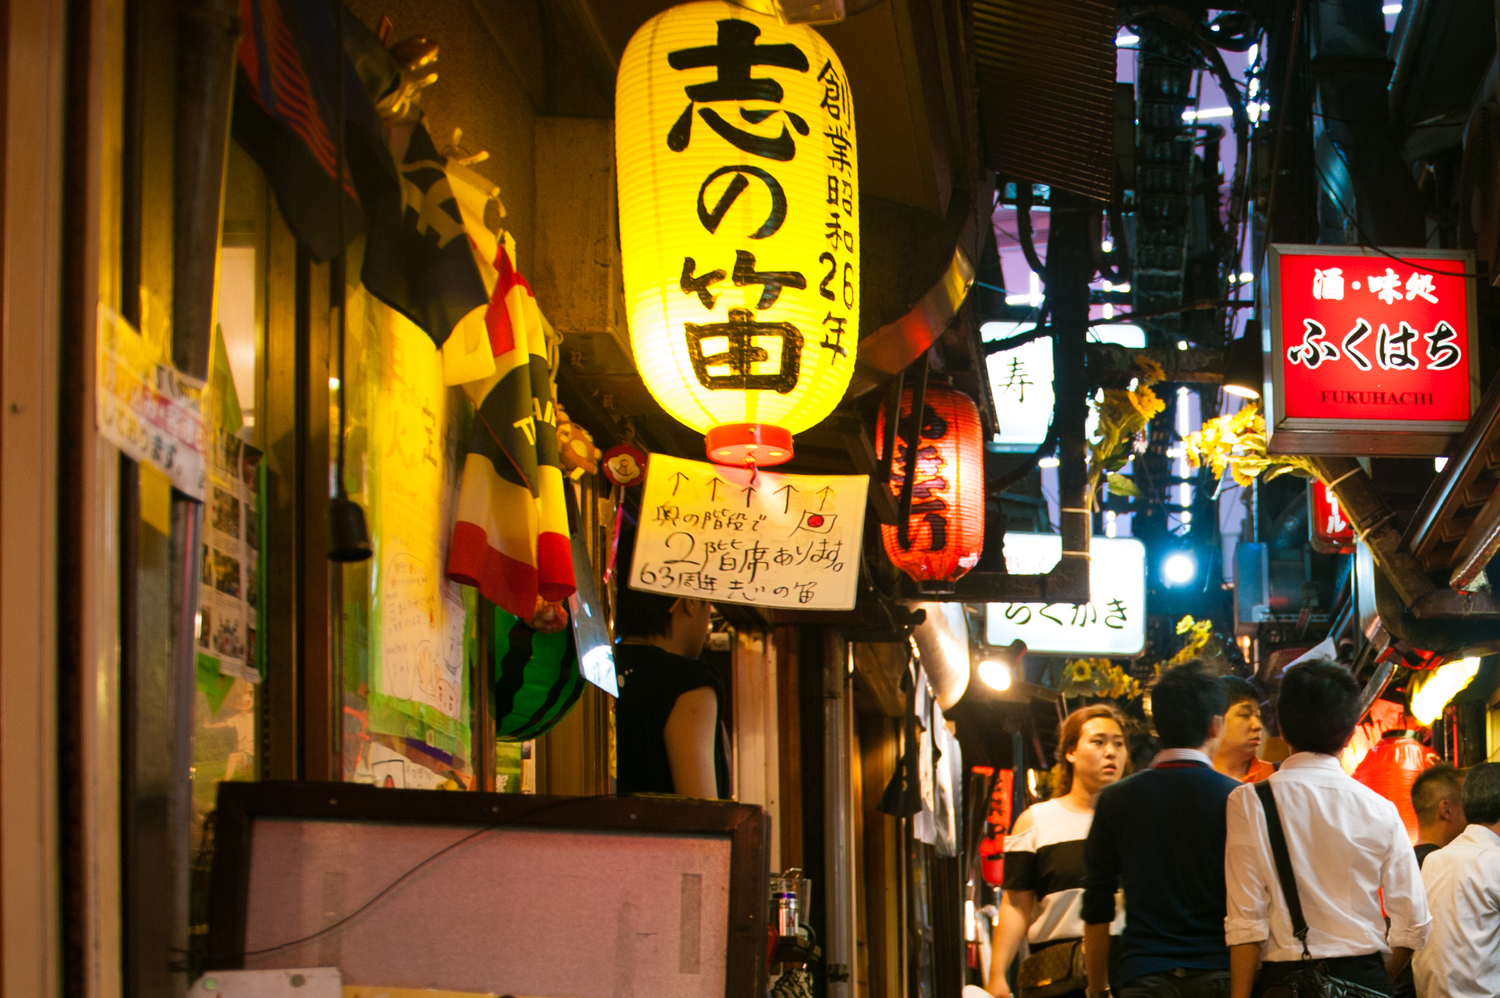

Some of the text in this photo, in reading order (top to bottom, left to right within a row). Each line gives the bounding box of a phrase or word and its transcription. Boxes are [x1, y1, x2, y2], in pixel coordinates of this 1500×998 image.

[666, 18, 809, 394] 志の笛
[817, 58, 855, 366] 創業昭和26年
[1312, 266, 1439, 305] 酒・味処
[1287, 317, 1462, 372] ふくはち
[998, 356, 1034, 404] 寿
[1321, 390, 1434, 406] FUKUHACHI
[640, 564, 718, 593] 63周年
[663, 532, 844, 584] 2階席あります。
